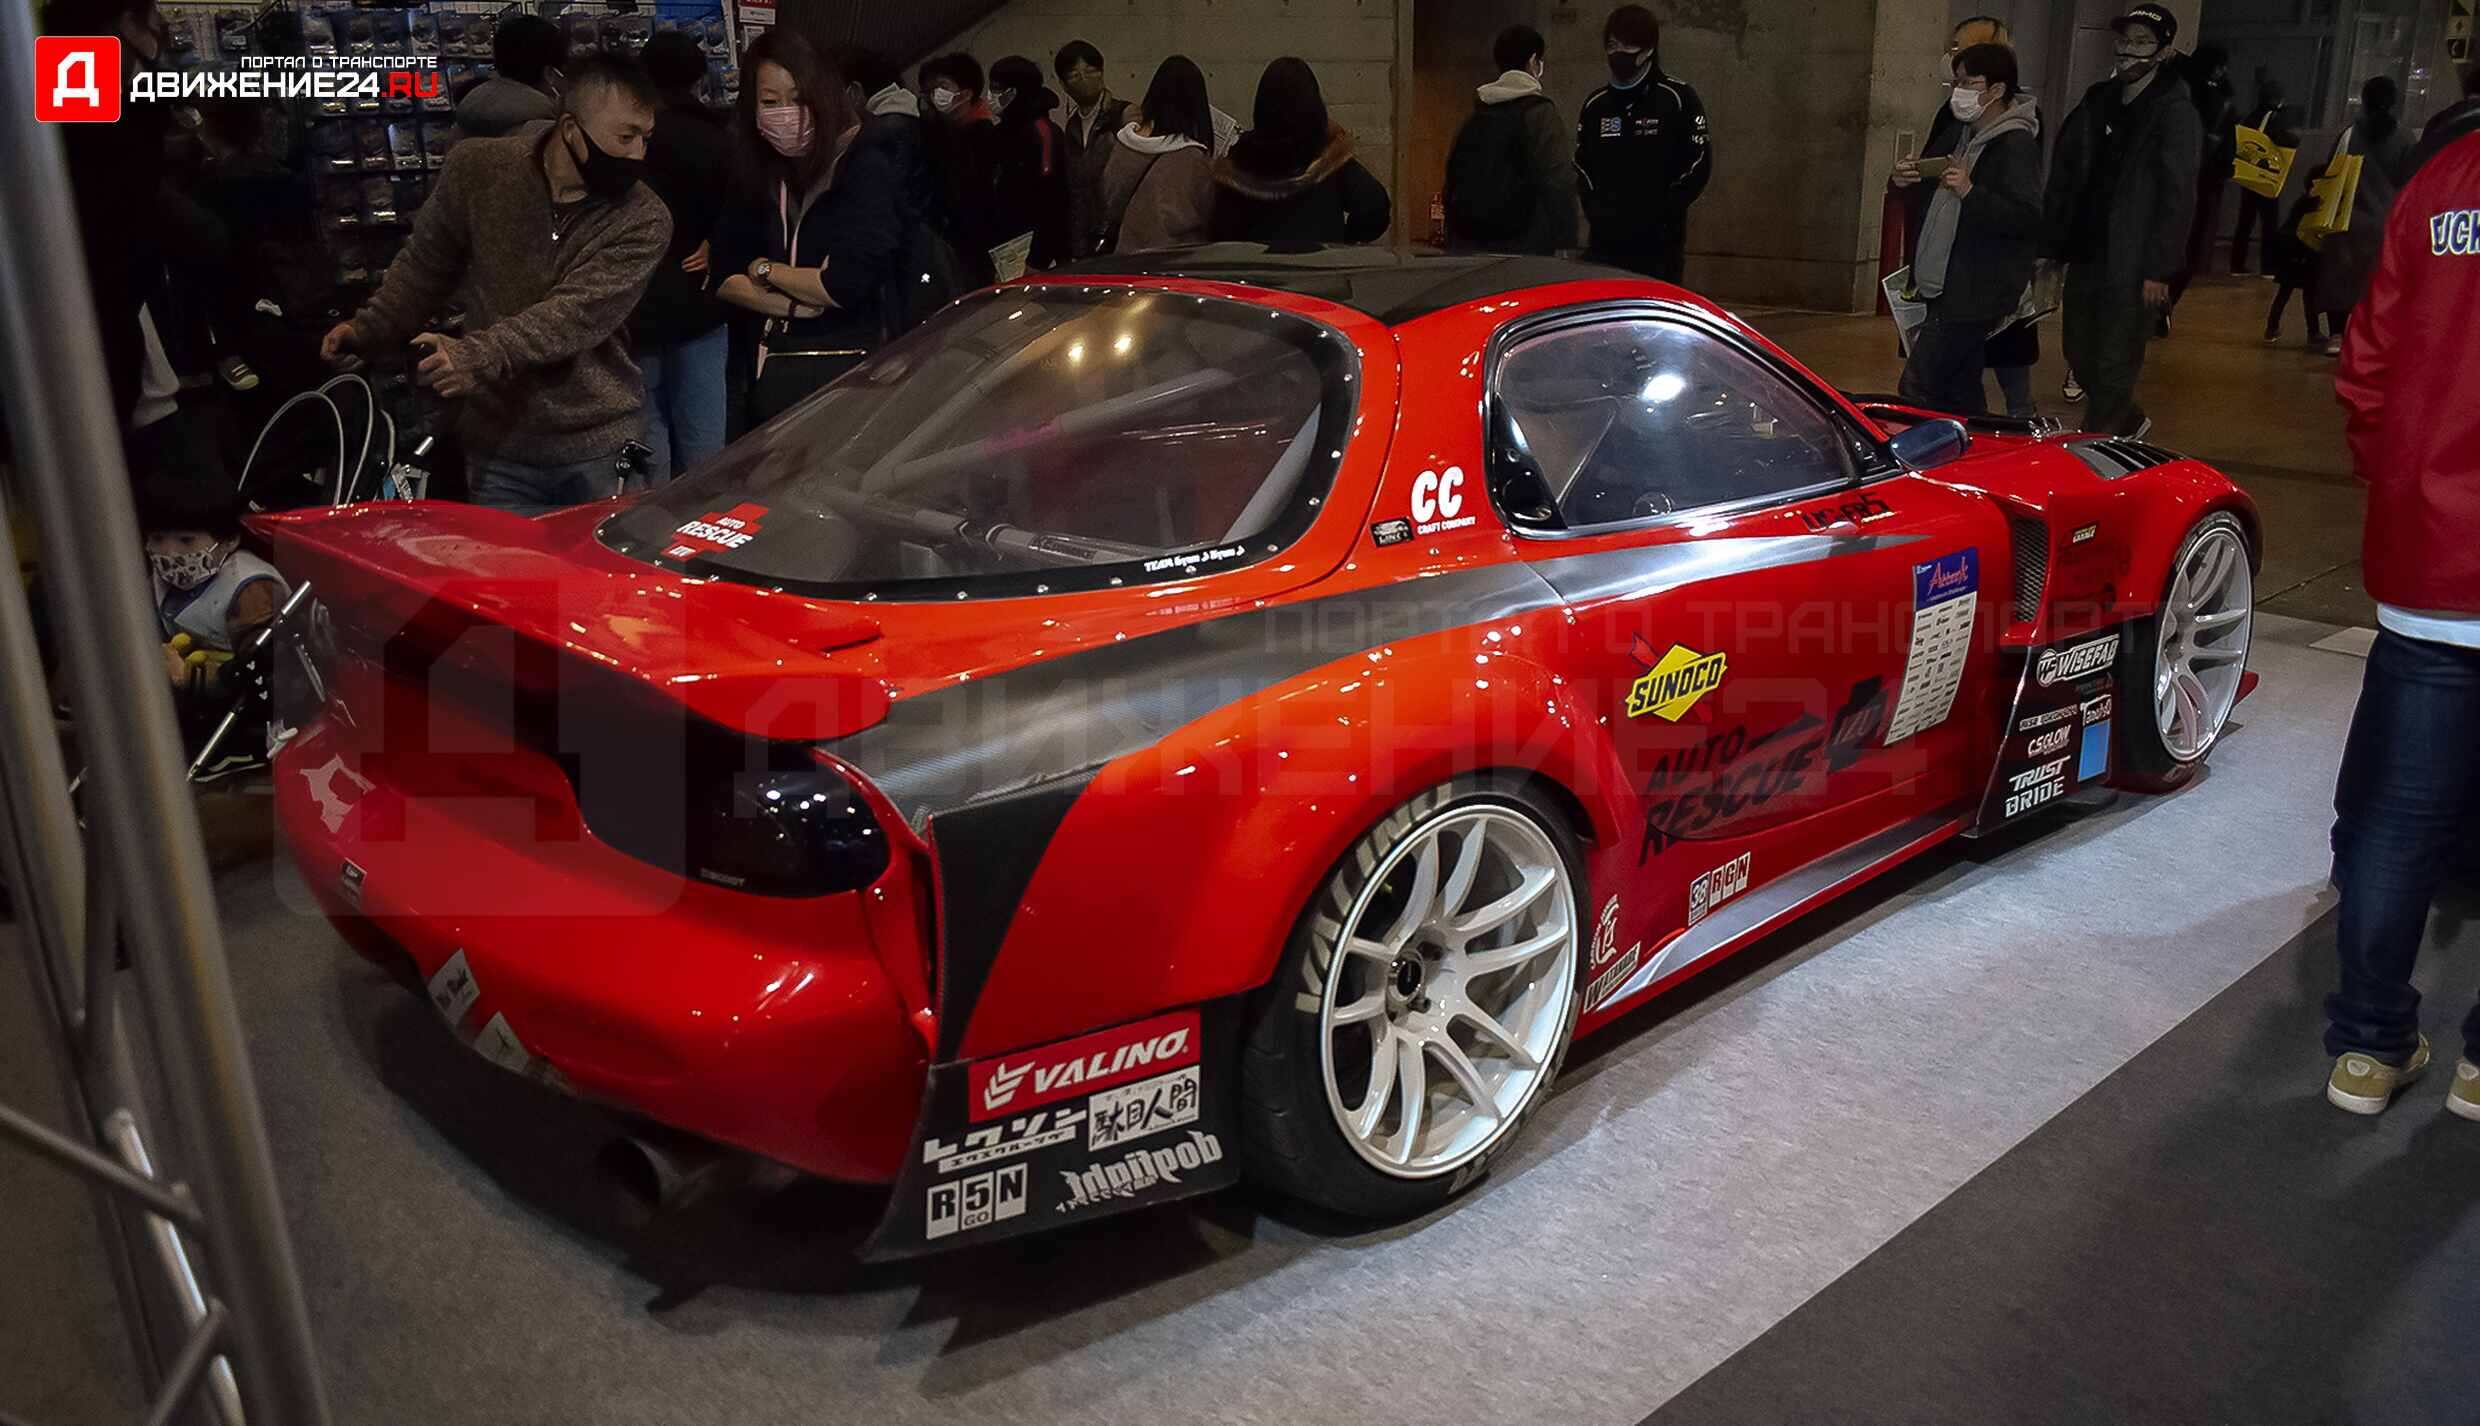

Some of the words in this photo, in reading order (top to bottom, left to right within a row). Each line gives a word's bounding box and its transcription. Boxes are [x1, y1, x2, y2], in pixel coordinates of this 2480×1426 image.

[1411, 466, 1464, 523] CC
[676, 520, 753, 548] RESCUE
[2057, 640, 2119, 677] WISEFAB
[1630, 656, 1724, 713] SUNOCO
[1646, 725, 1747, 791] AUTO
[2009, 755, 2072, 792] TRUST
[1637, 738, 1823, 868] RESCUE
[2004, 775, 2065, 818] BRIDE
[1034, 1028, 1190, 1094] VALINO
[963, 1210, 990, 1228] GO
